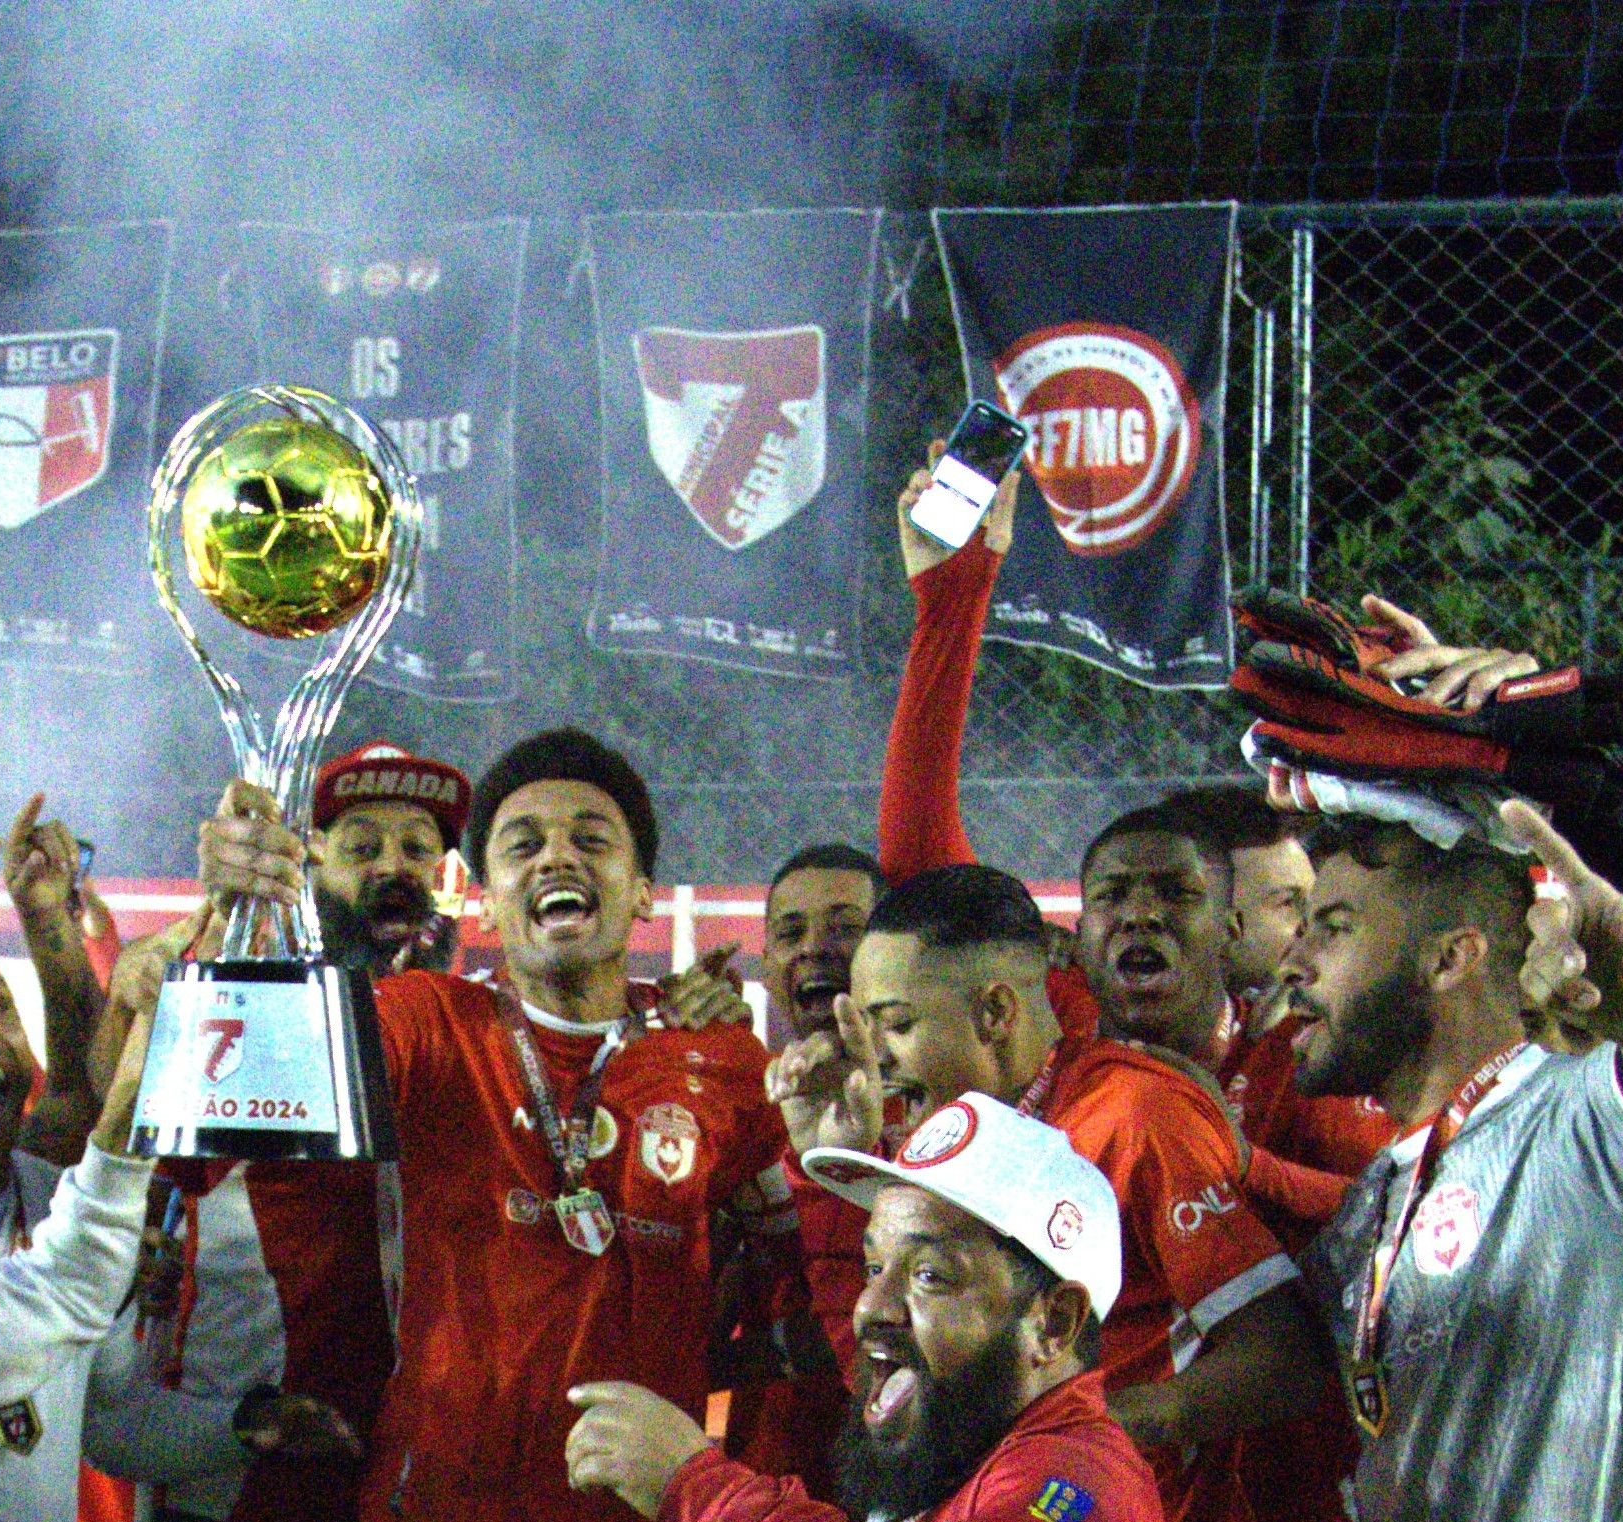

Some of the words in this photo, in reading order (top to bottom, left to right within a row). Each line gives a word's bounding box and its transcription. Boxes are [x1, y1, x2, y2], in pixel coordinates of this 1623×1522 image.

[4, 342, 96, 373] BELO
[333, 771, 460, 803] CANADA
[1460, 1081, 1477, 1102] F7
[1474, 1054, 1506, 1086] BELO
[245, 1098, 308, 1120] 2024
